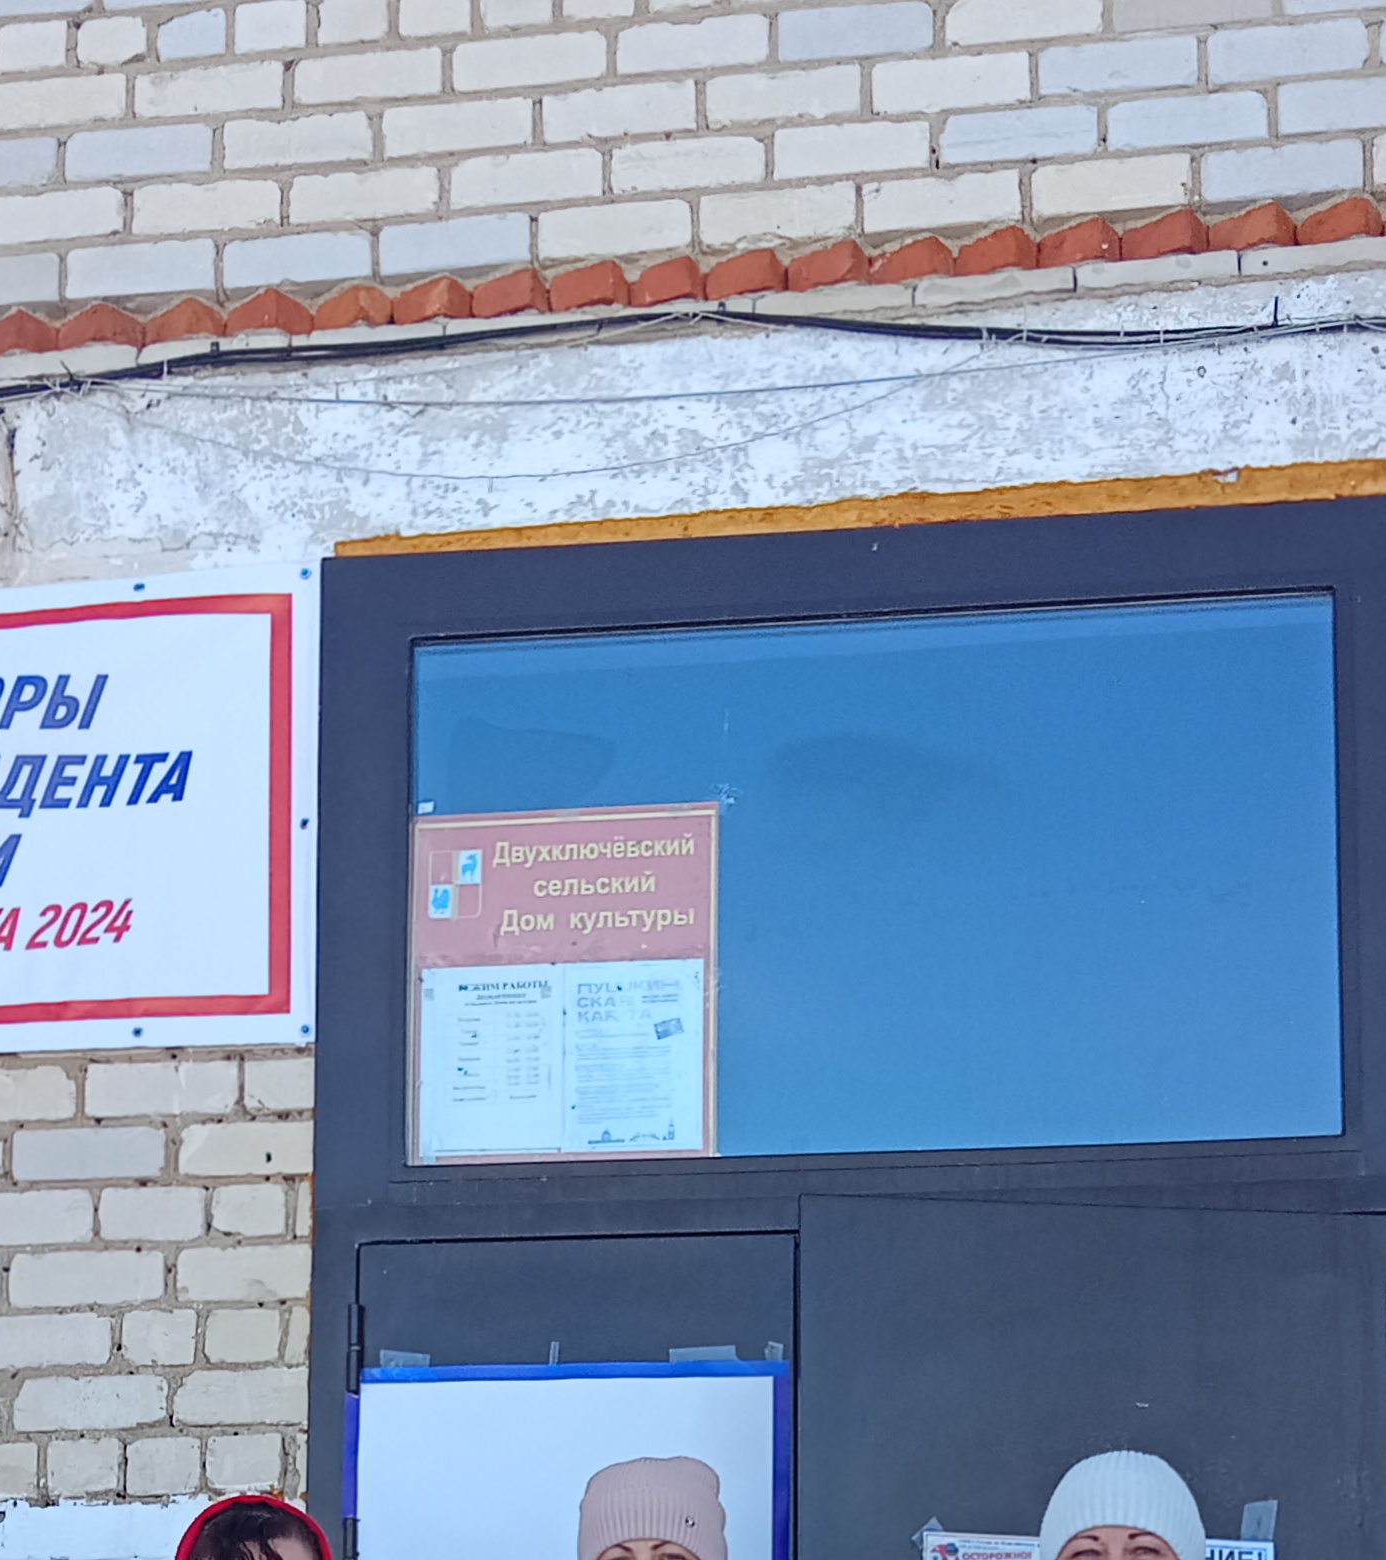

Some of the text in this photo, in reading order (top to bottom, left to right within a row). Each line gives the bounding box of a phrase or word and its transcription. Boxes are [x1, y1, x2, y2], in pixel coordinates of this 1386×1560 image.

[493, 832, 695, 867] Двухключёвский
[533, 869, 657, 898] сельский
[25, 898, 135, 952] 2024
[500, 905, 696, 936] Дом культуры
